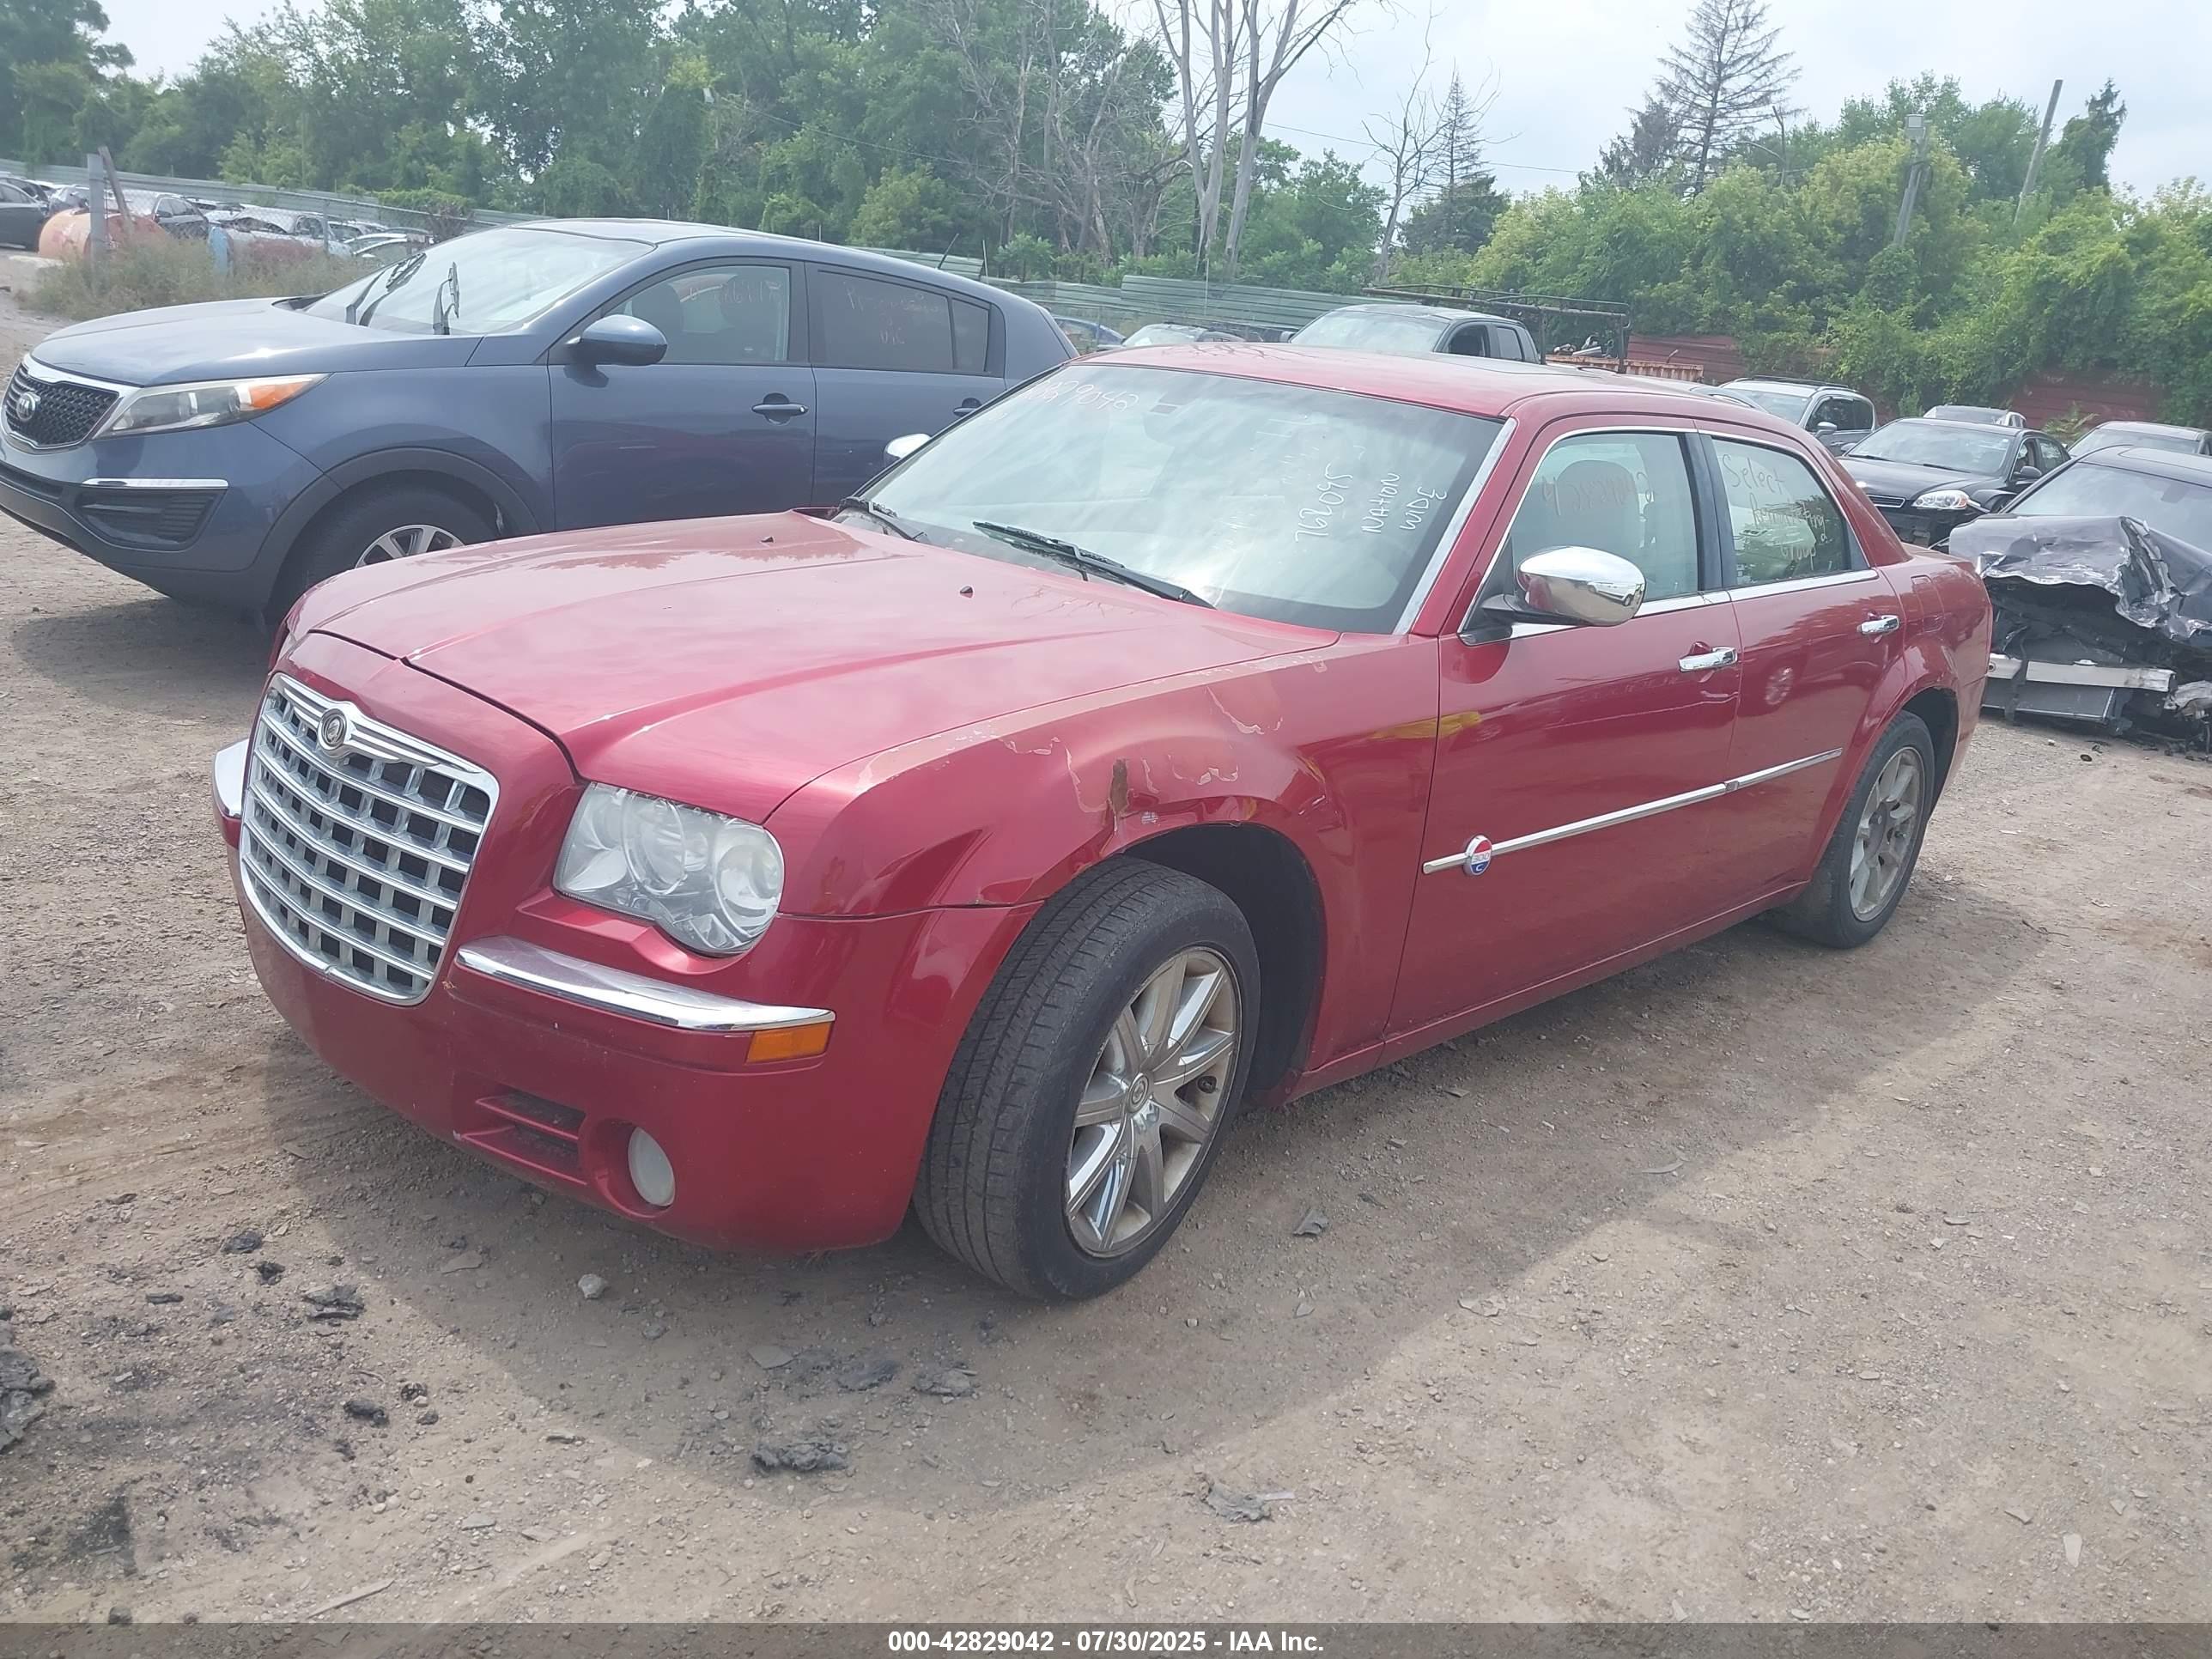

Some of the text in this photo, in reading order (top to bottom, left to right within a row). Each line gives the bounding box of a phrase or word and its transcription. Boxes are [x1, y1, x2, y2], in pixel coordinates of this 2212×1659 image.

[1722, 453, 1786, 495] Select
[1361, 472, 1401, 534] NATION
[1400, 486, 1448, 532] WIDE
